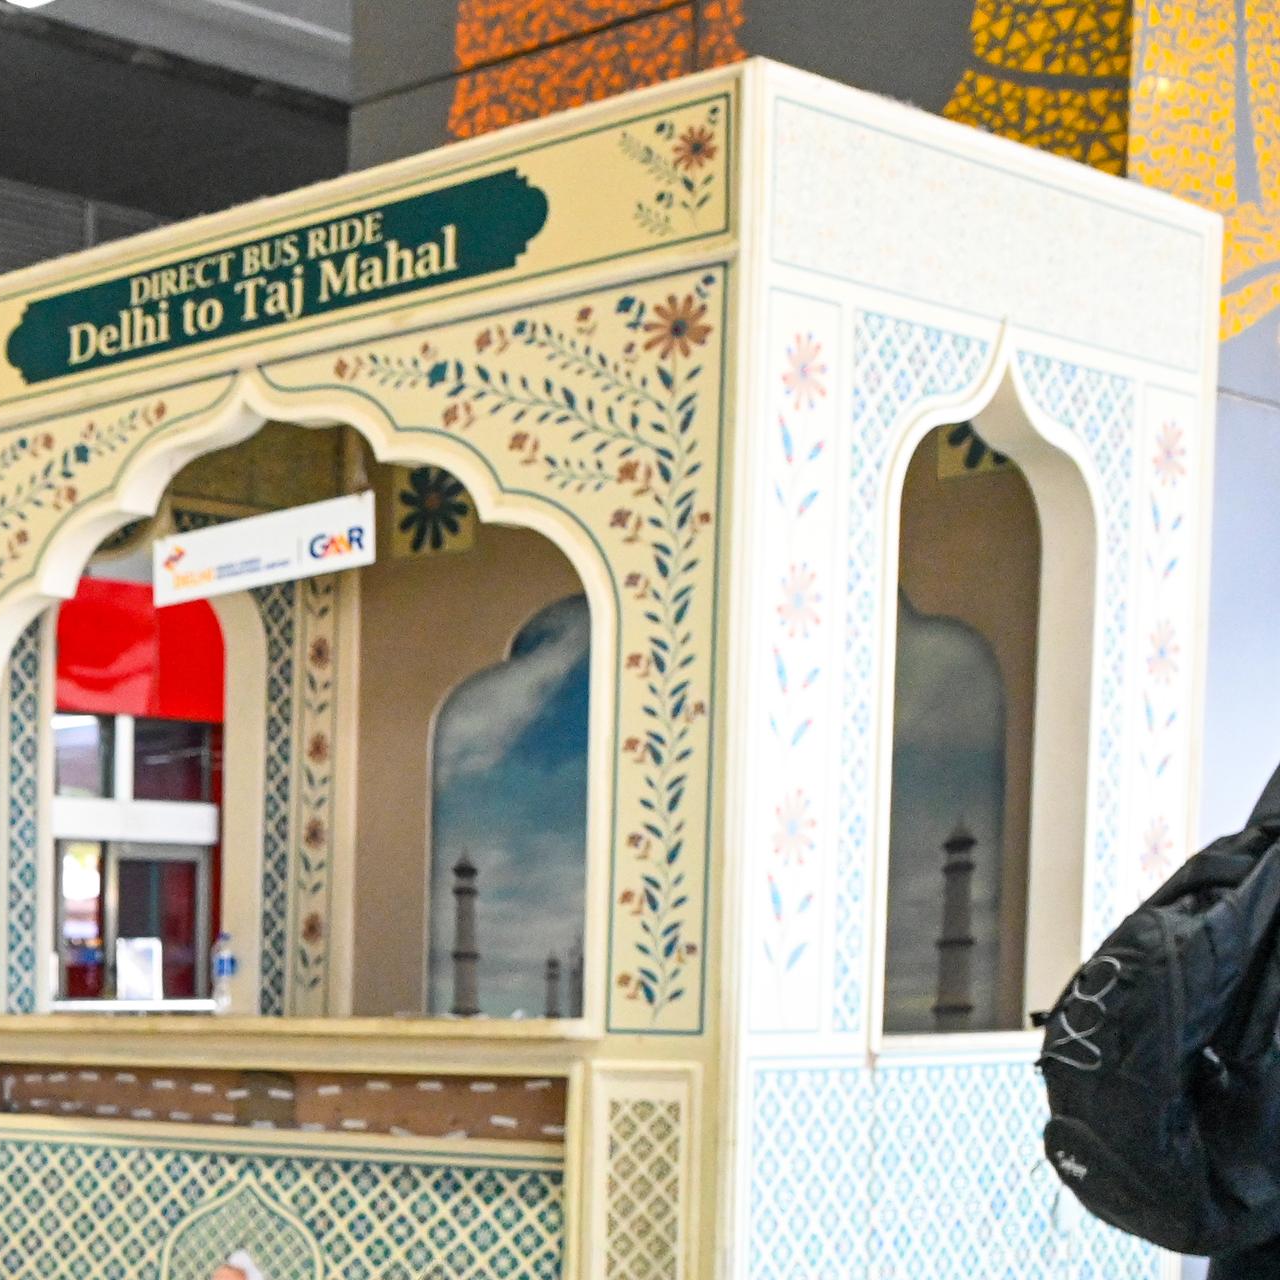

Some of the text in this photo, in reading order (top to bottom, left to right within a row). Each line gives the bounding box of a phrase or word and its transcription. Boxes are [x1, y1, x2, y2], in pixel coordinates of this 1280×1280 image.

[68, 223, 460, 366] Delhi to Taj Mahal
[130, 211, 385, 305] DIRECT BUS RIDE
